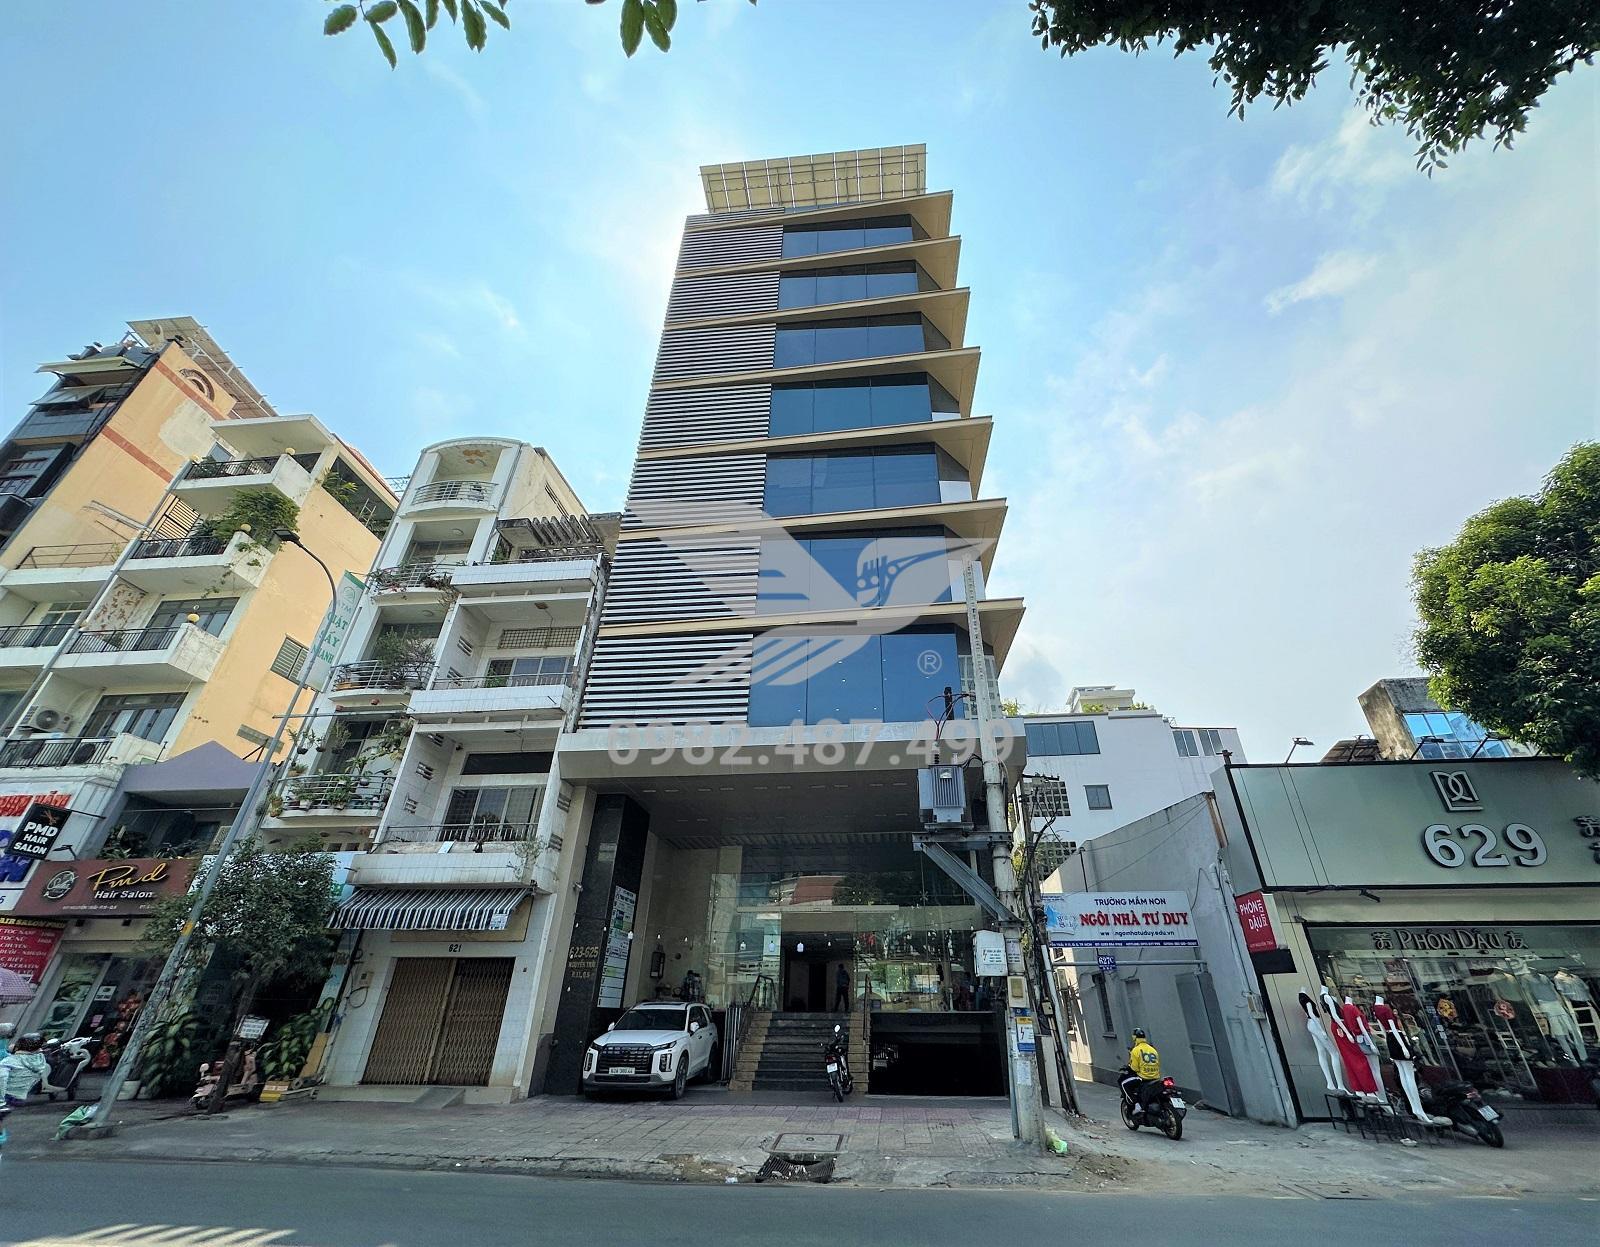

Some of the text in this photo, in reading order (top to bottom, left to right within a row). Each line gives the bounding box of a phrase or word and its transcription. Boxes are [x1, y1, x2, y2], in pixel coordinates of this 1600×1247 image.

[24, 821, 58, 837] PMD
[23, 833, 49, 845] HAIR
[1423, 822, 1548, 867] 629
[13, 842, 48, 855] SALON
[94, 890, 153, 899] Hair Salon
[1239, 900, 1259, 915] PHÓN
[1079, 910, 1110, 926] NGÔI
[1112, 909, 1141, 926] NHÀ
[1142, 911, 1160, 926] TƯ
[1161, 912, 1188, 926] DUY
[1248, 915, 1263, 932] DẬU
[1395, 928, 1456, 950] PHÓN
[448, 944, 462, 953] 621
[1140, 1049, 1157, 1063] be
